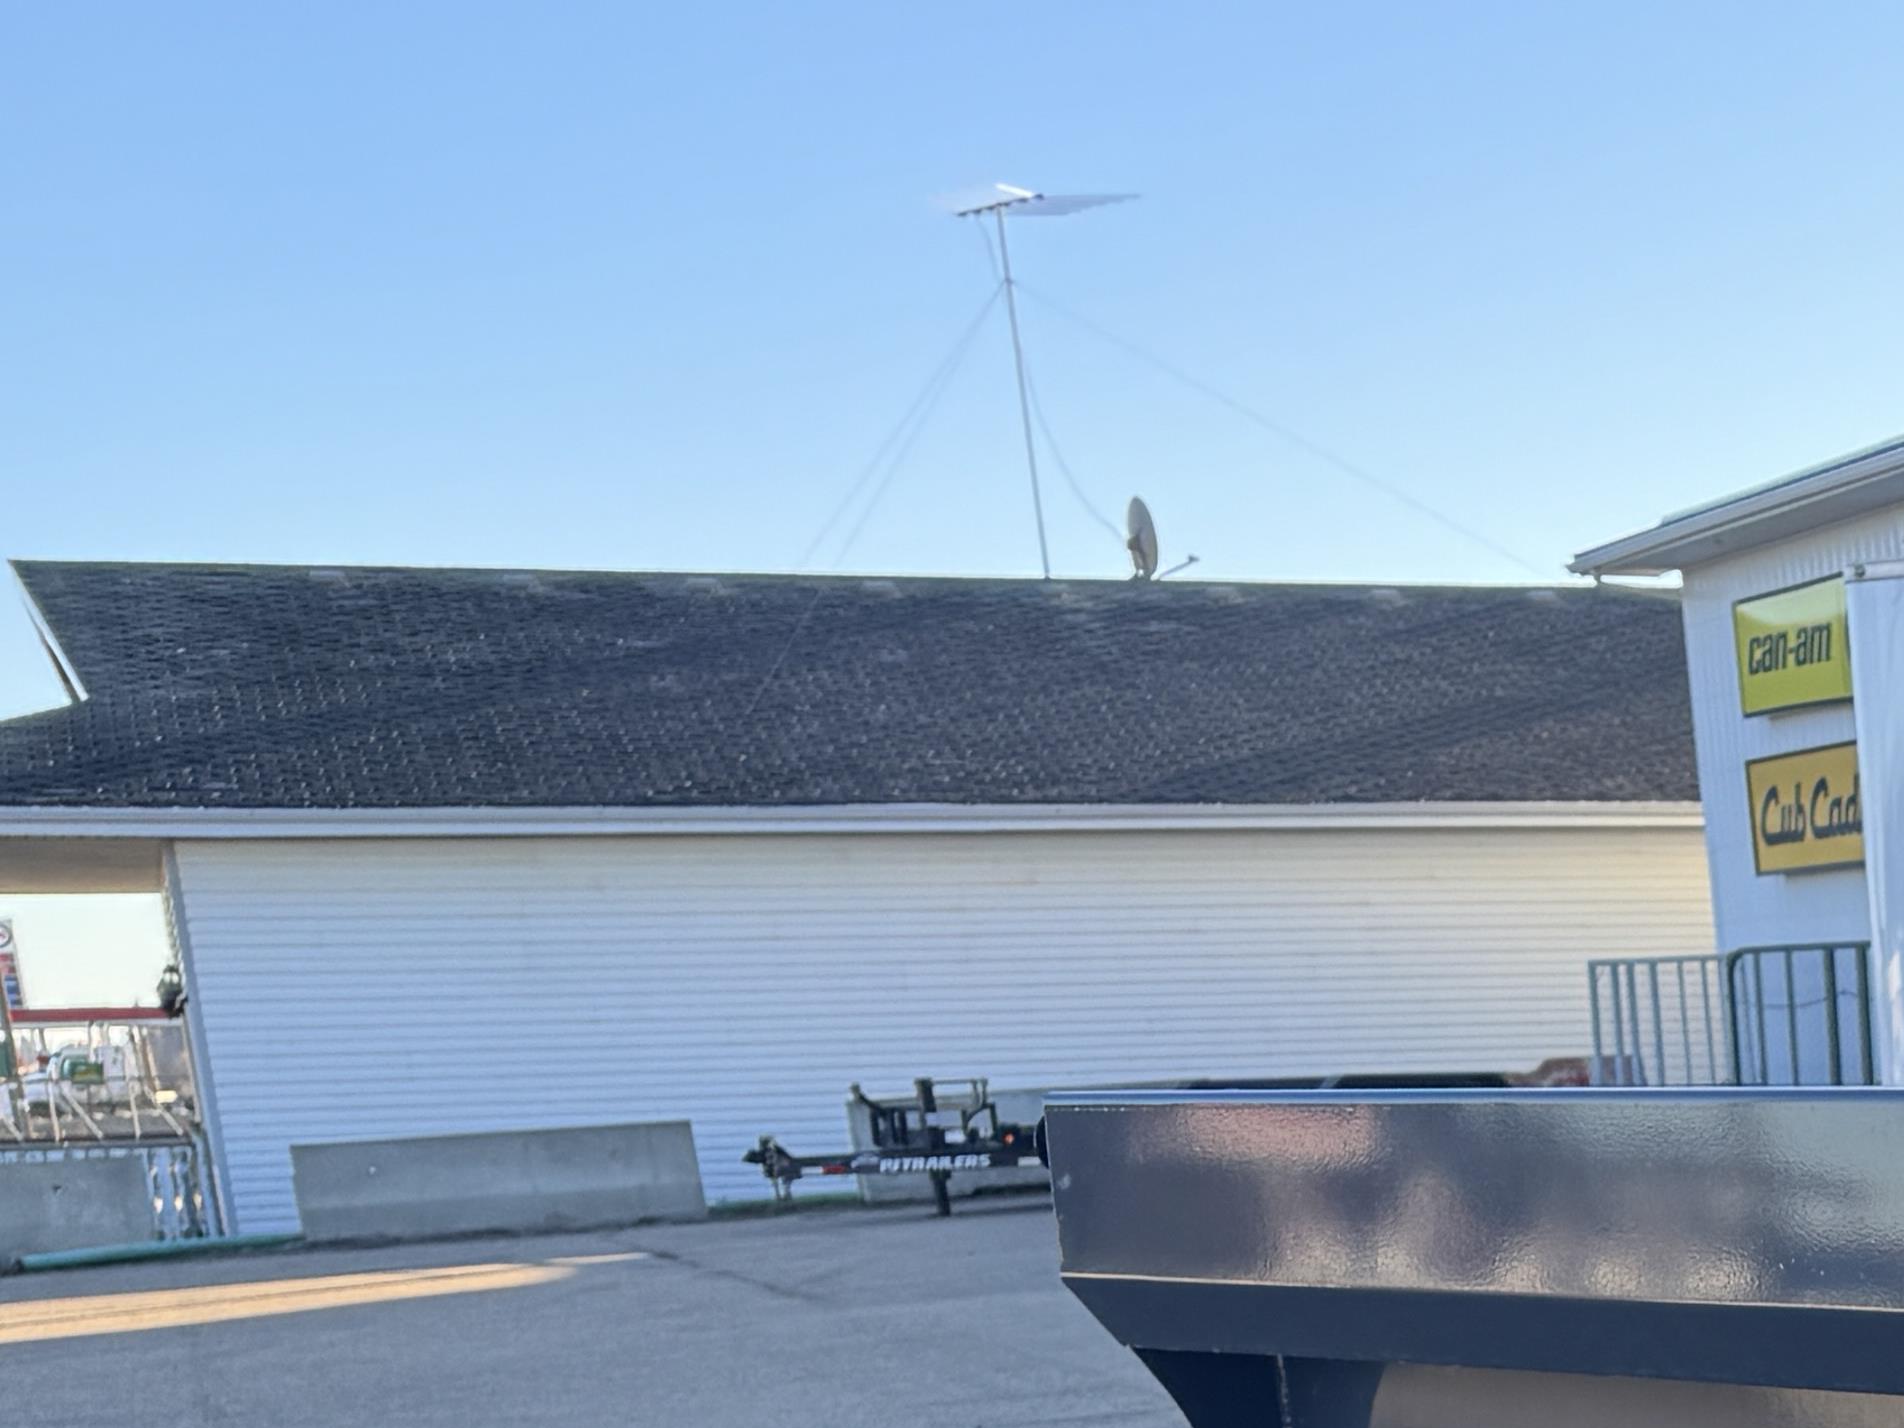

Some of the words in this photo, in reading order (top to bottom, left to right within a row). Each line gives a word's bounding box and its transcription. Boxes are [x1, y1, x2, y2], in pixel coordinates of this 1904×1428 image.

[1748, 621, 1831, 676] can-am
[1761, 781, 1806, 846] Cub
[1809, 773, 1863, 840] Cad
